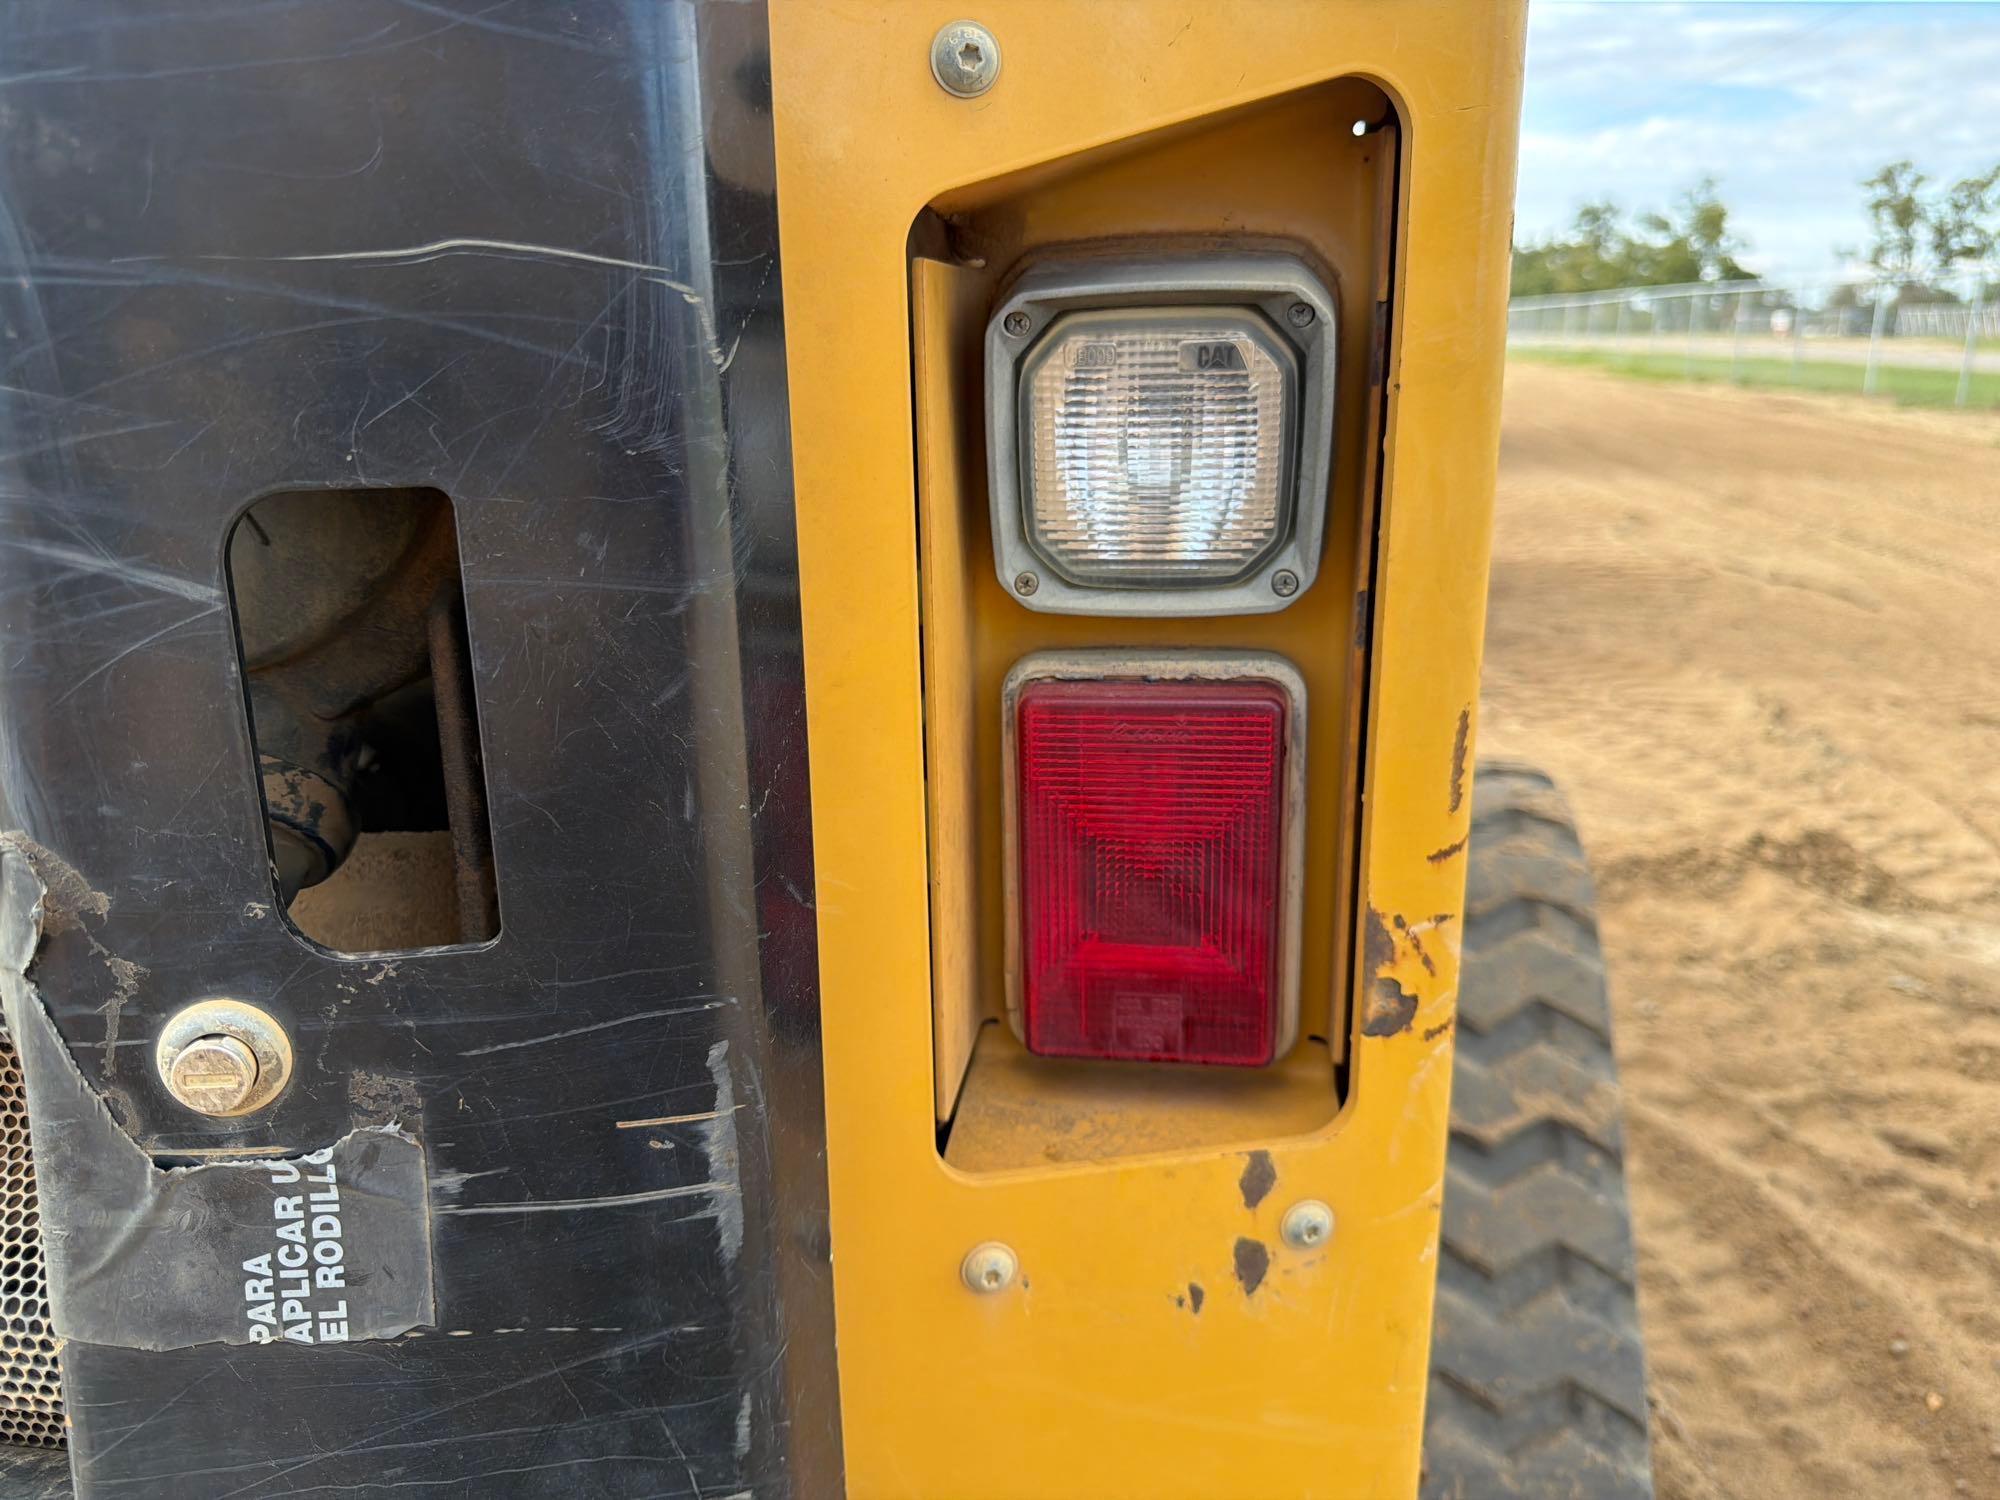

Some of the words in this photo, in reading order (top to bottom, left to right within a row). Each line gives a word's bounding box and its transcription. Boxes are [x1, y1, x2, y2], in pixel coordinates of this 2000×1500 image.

[1197, 345, 1237, 368] CAT
[243, 1253, 276, 1344] PARA
[274, 1196, 314, 1343] APLICAR
[319, 1300, 348, 1341] EL
